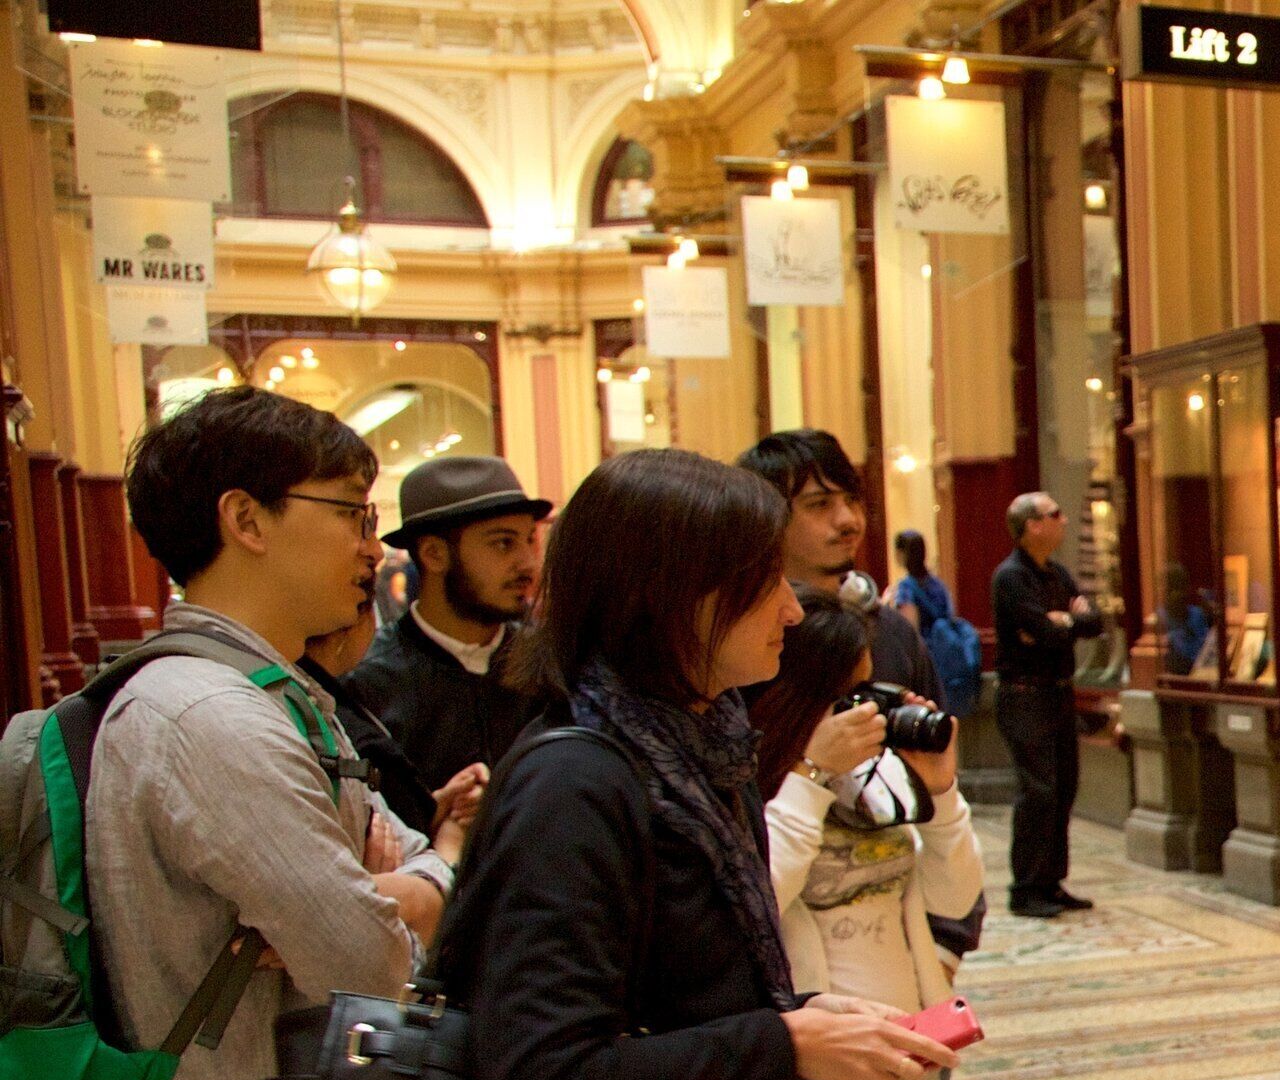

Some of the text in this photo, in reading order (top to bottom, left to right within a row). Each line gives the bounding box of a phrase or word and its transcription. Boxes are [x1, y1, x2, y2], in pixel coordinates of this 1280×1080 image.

[1168, 25, 1258, 65] Lift 2
[103, 257, 206, 282] MR WARES
